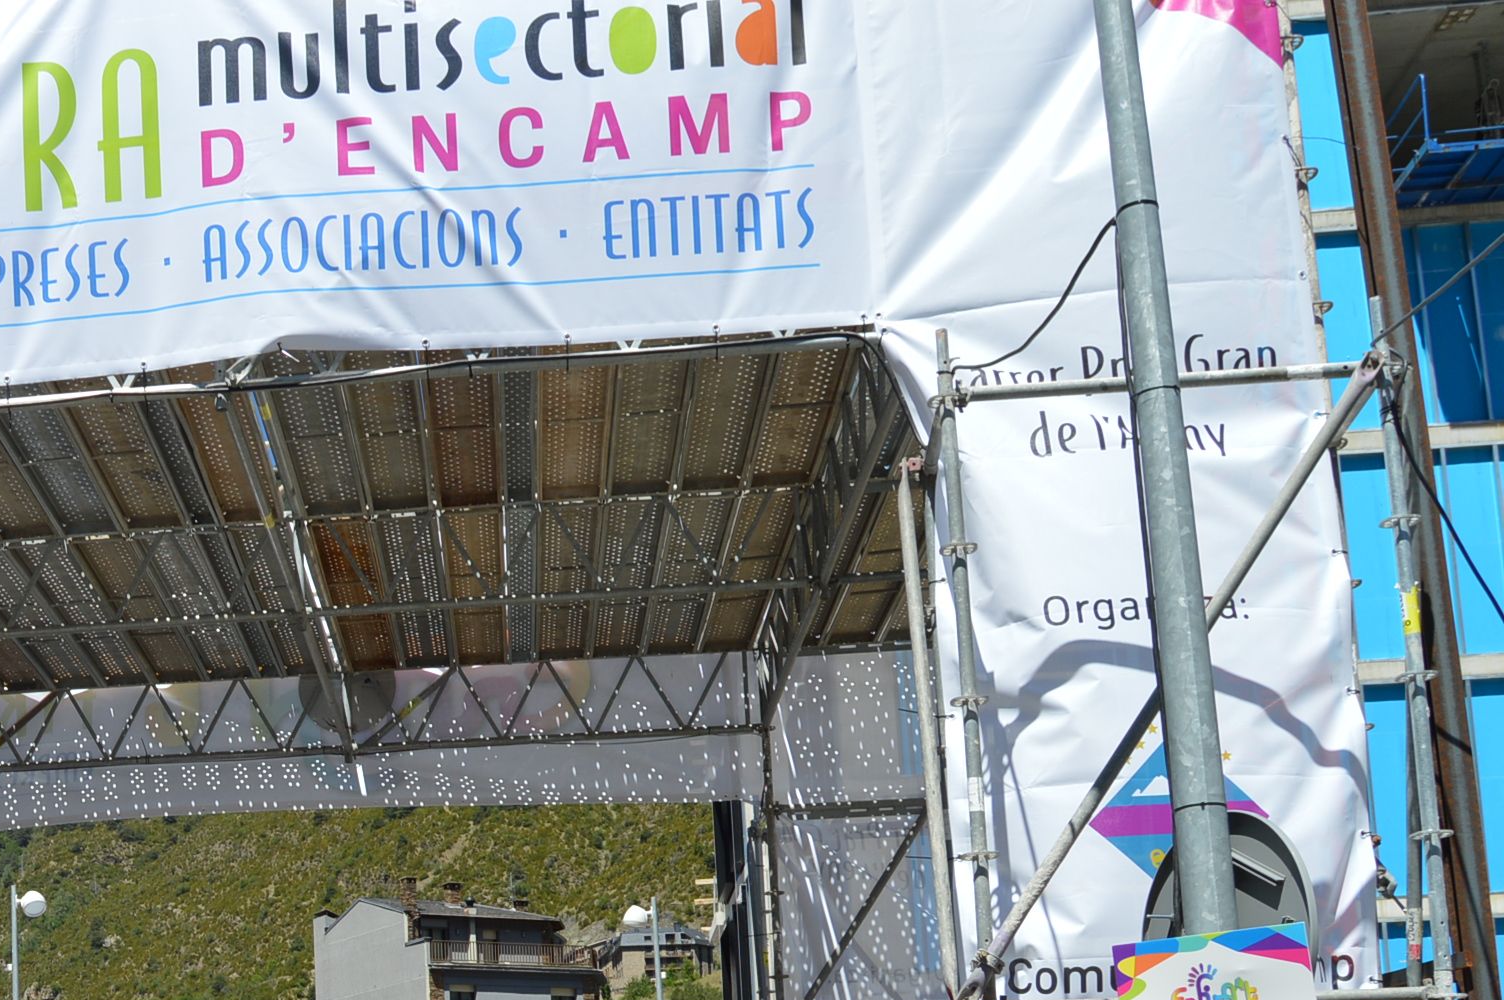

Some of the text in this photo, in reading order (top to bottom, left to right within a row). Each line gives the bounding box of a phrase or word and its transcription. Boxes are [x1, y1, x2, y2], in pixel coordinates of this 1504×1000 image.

[197, 0, 807, 106] multisectorial
[200, 91, 813, 188] D'ENCAMP
[202, 206, 524, 283] ASSOCIACIONS
[602, 187, 817, 260] ENTITATS
[1183, 333, 1278, 373] Gran
[1030, 410, 1078, 458] de
